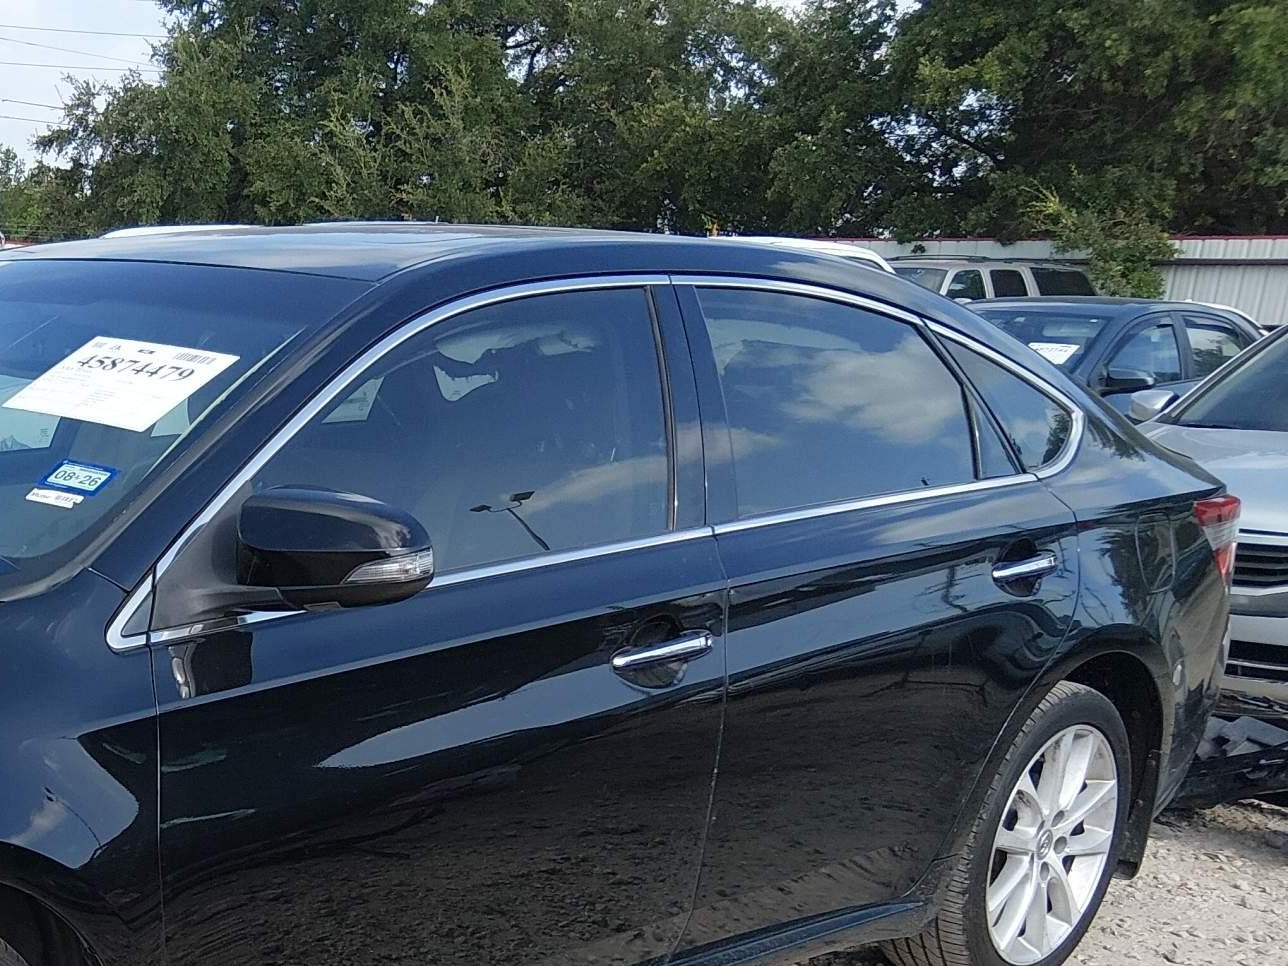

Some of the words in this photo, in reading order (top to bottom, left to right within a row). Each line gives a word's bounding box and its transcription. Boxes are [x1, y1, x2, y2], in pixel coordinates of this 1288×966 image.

[77, 354, 196, 381] 45874479
[54, 470, 76, 482] 08
[78, 475, 102, 487] 26
